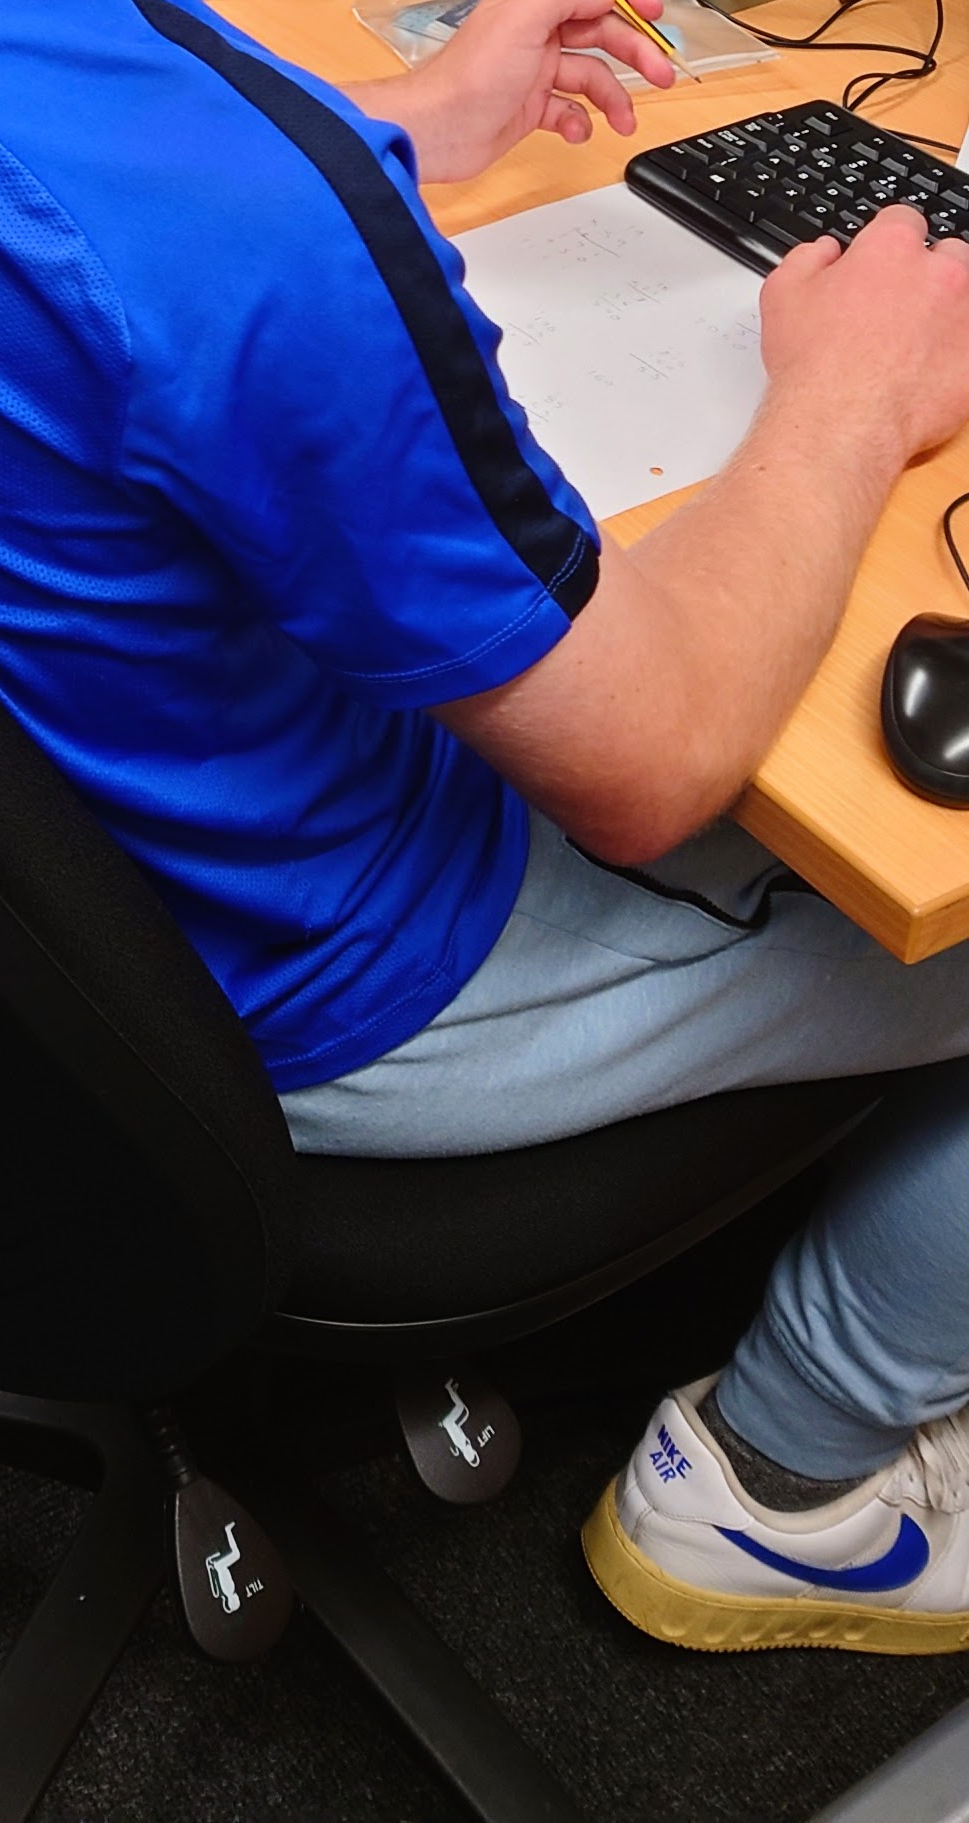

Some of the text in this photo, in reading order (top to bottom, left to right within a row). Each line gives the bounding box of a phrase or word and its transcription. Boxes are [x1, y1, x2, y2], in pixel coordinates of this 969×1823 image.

[478, 1424, 495, 1448] LIFT
[657, 1425, 693, 1480] NIKE
[649, 1451, 677, 1483] AIR
[245, 1578, 264, 1598] TILT
